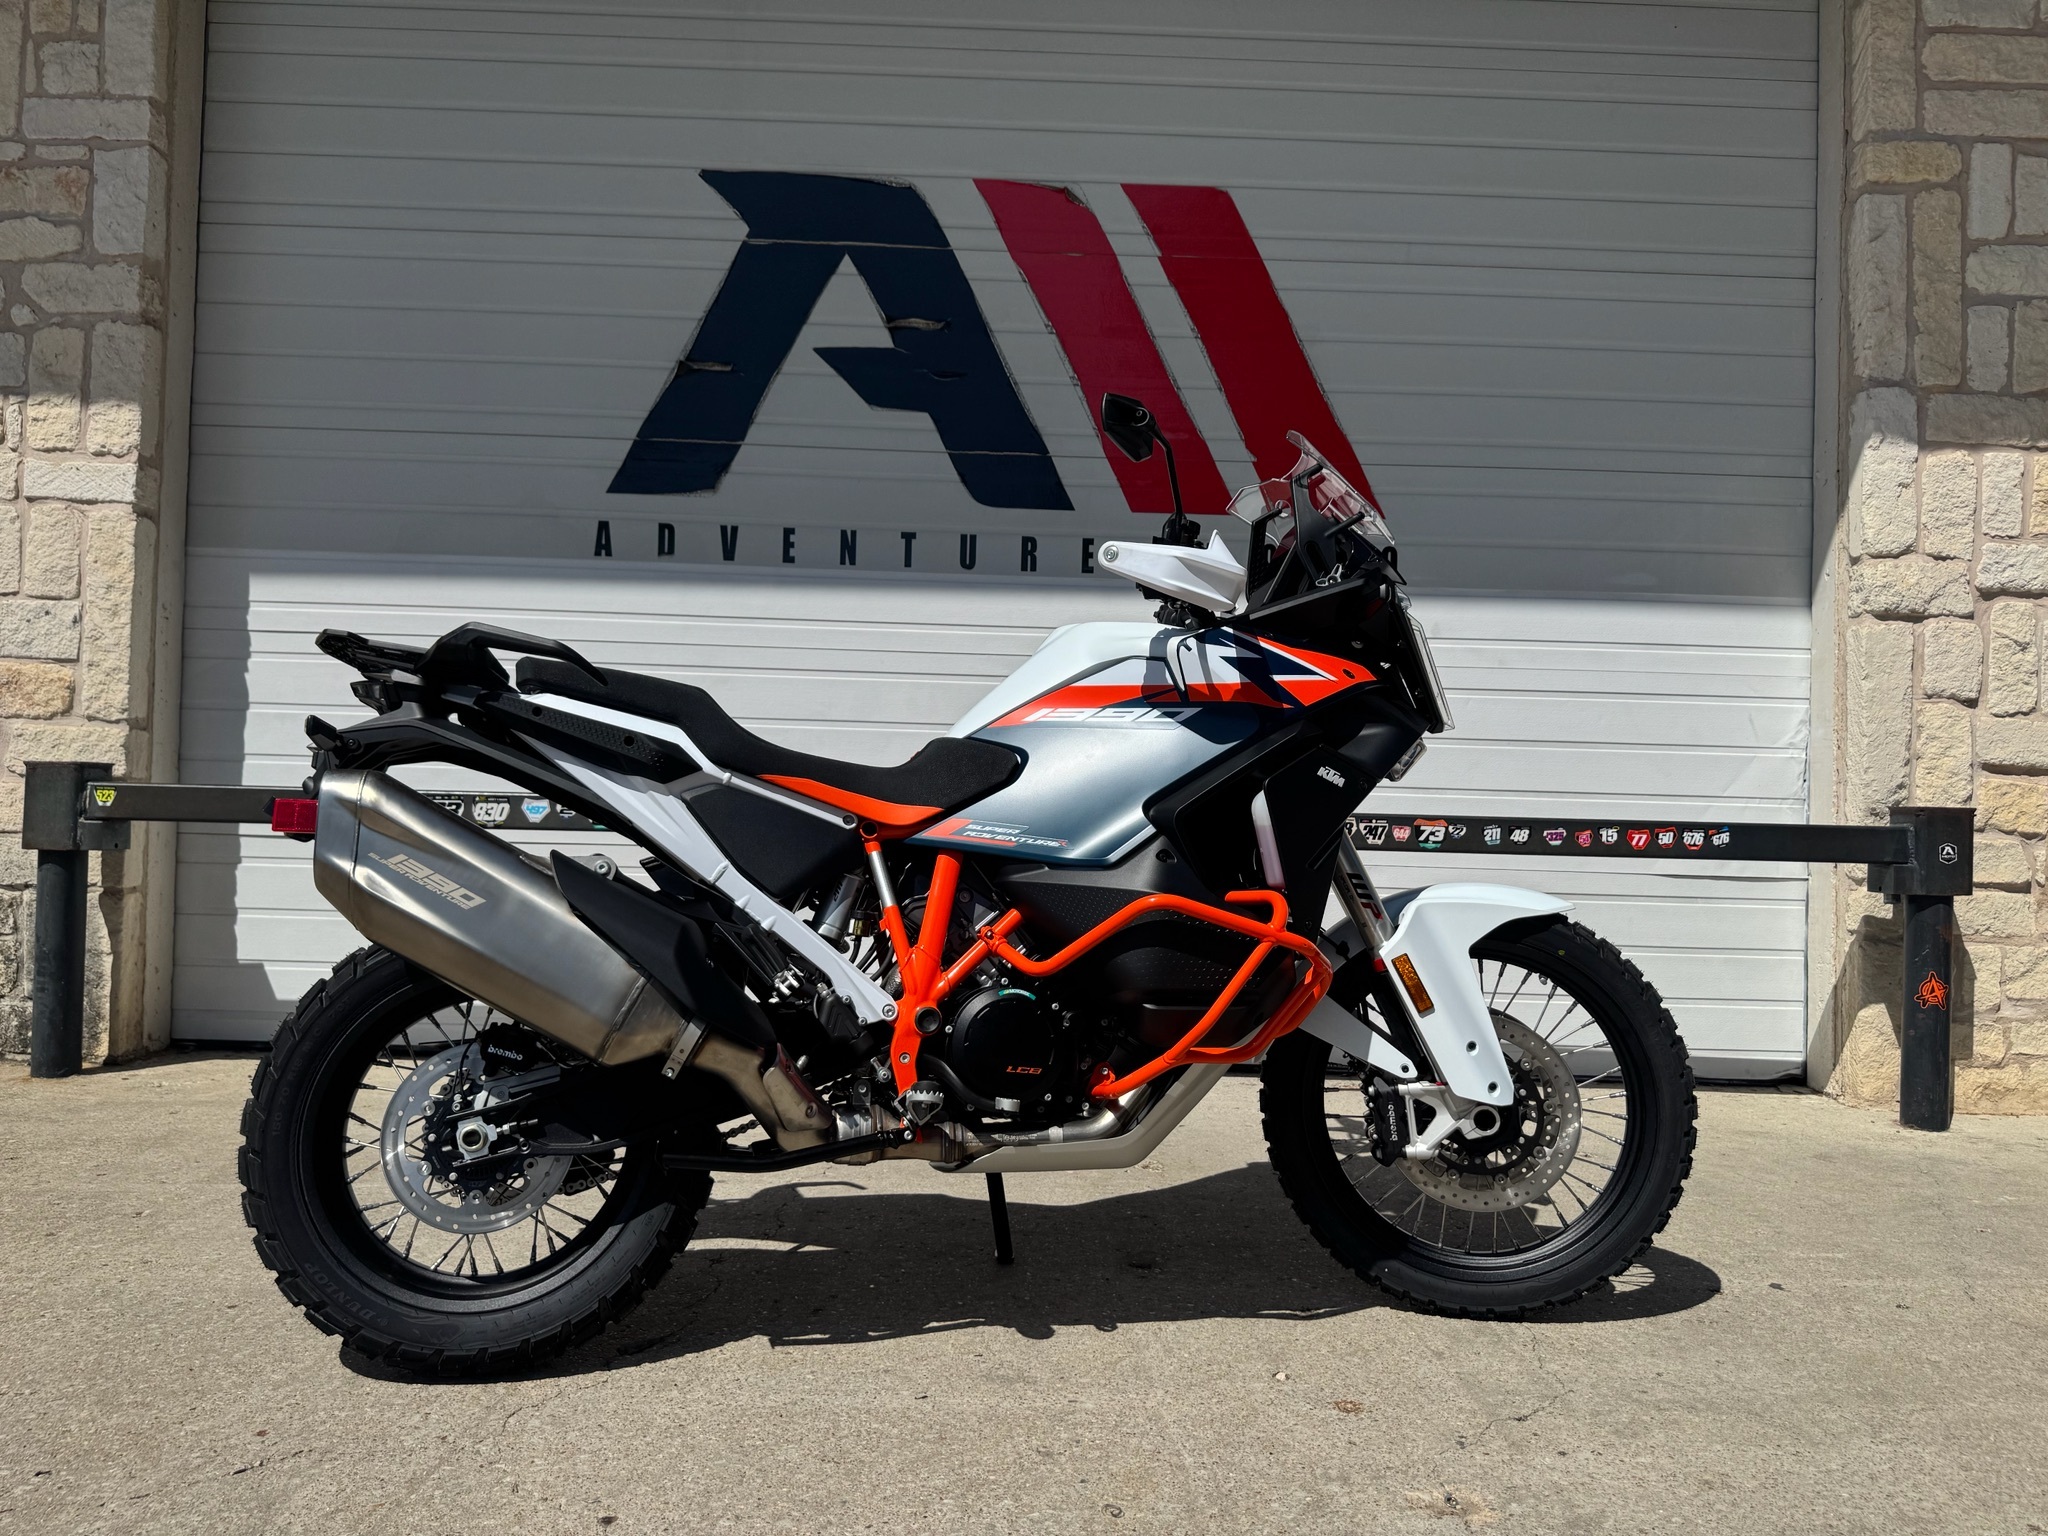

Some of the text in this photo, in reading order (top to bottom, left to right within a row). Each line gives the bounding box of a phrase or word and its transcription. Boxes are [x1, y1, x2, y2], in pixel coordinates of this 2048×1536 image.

[594, 520, 1095, 574] ADVENTURE
[1317, 766, 1345, 788] KTM
[475, 803, 509, 821] 830
[526, 805, 547, 815] 497
[965, 824, 1021, 834] SUPER
[1363, 825, 1387, 840] 247
[1417, 826, 1446, 841] 73
[1484, 828, 1501, 841] 211
[1510, 829, 1530, 842] 48
[1600, 828, 1618, 842] 15
[963, 831, 1060, 847] ADVENTURE
[1631, 834, 1647, 845] 77
[1658, 832, 1674, 845] 50
[1346, 872, 1383, 920] WP
[488, 1044, 523, 1060] brembo
[1006, 1065, 1042, 1075] LC8
[1387, 1103, 1398, 1141] brembo
[304, 1262, 377, 1321] DUNLOP
